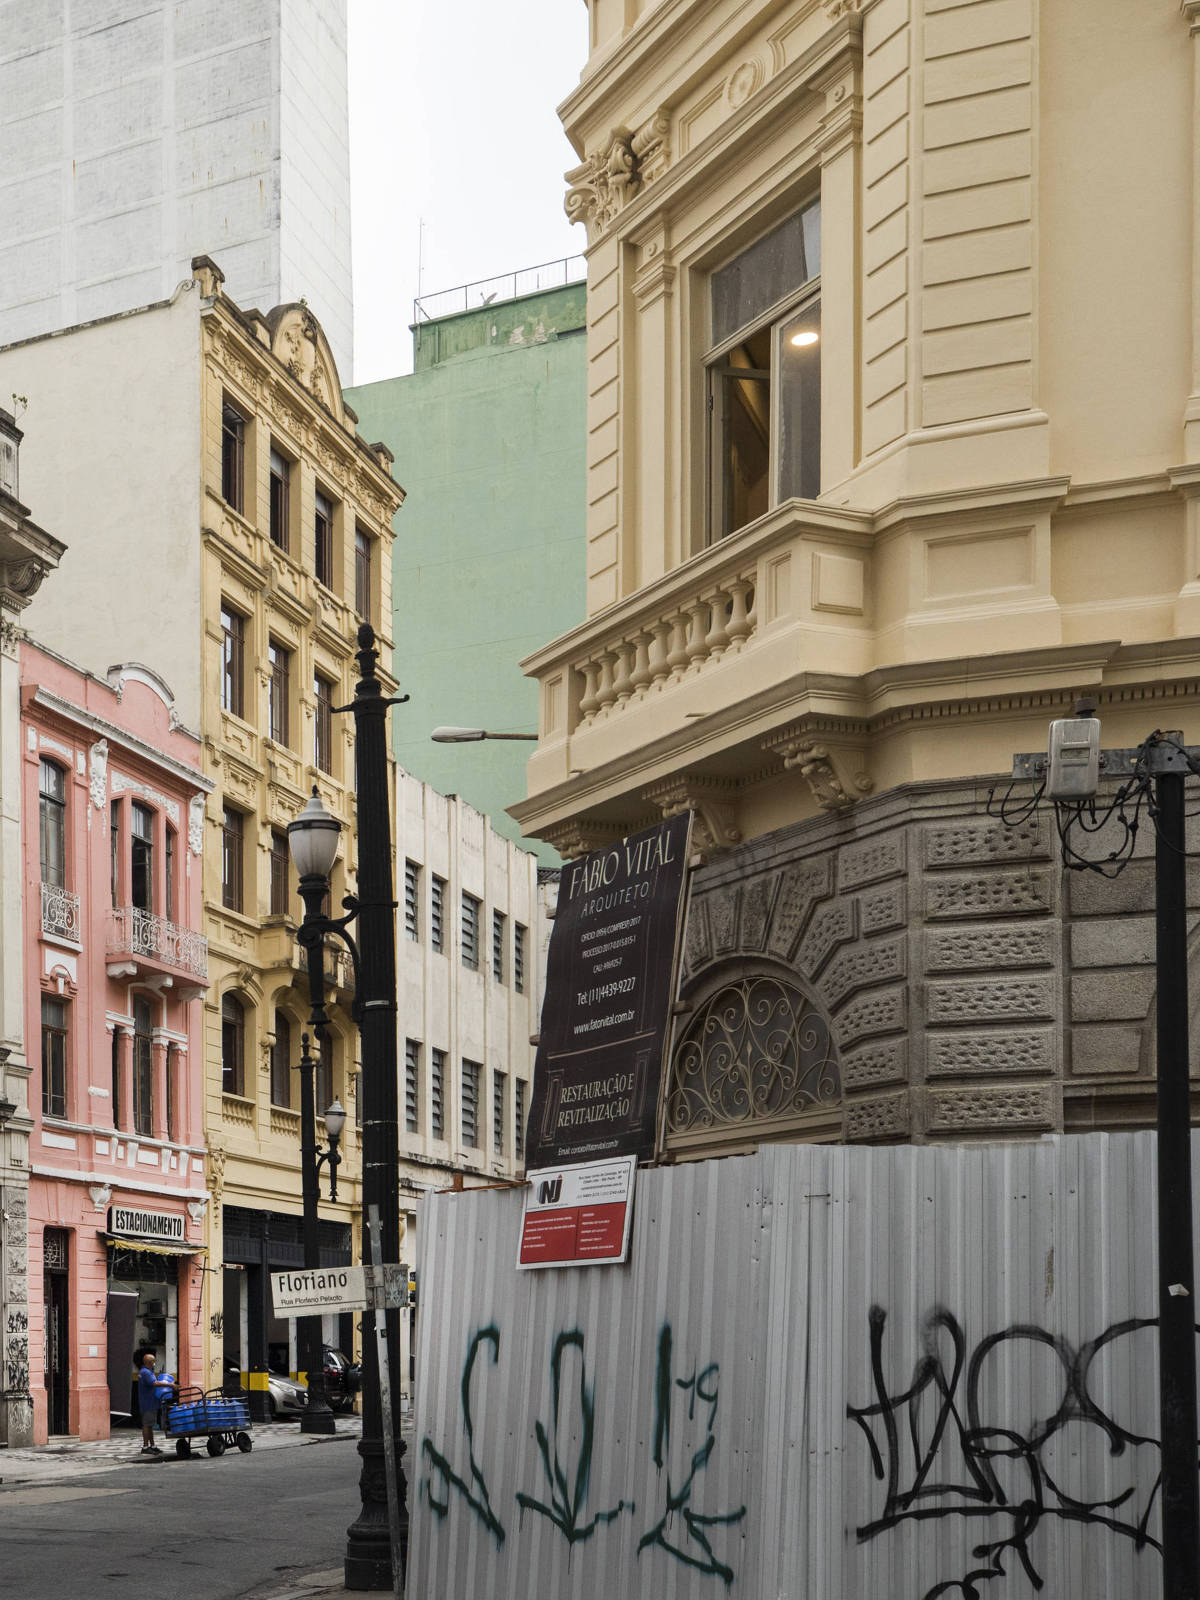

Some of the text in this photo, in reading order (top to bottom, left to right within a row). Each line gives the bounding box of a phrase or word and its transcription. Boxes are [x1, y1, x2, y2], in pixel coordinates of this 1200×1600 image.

[569, 831, 675, 900] FÁBIO VITAL
[581, 881, 650, 918] ARQUITETO
[573, 1009, 636, 1035] www.fatorvital.com.br
[560, 1072, 635, 1104] RESTAURAÇÃO E
[558, 1097, 630, 1128] REVITALIZAÇÃO
[115, 1209, 182, 1237] ESTACIONAMENTO
[278, 1271, 348, 1293] Floriano
[295, 1296, 319, 1304] Floriano
